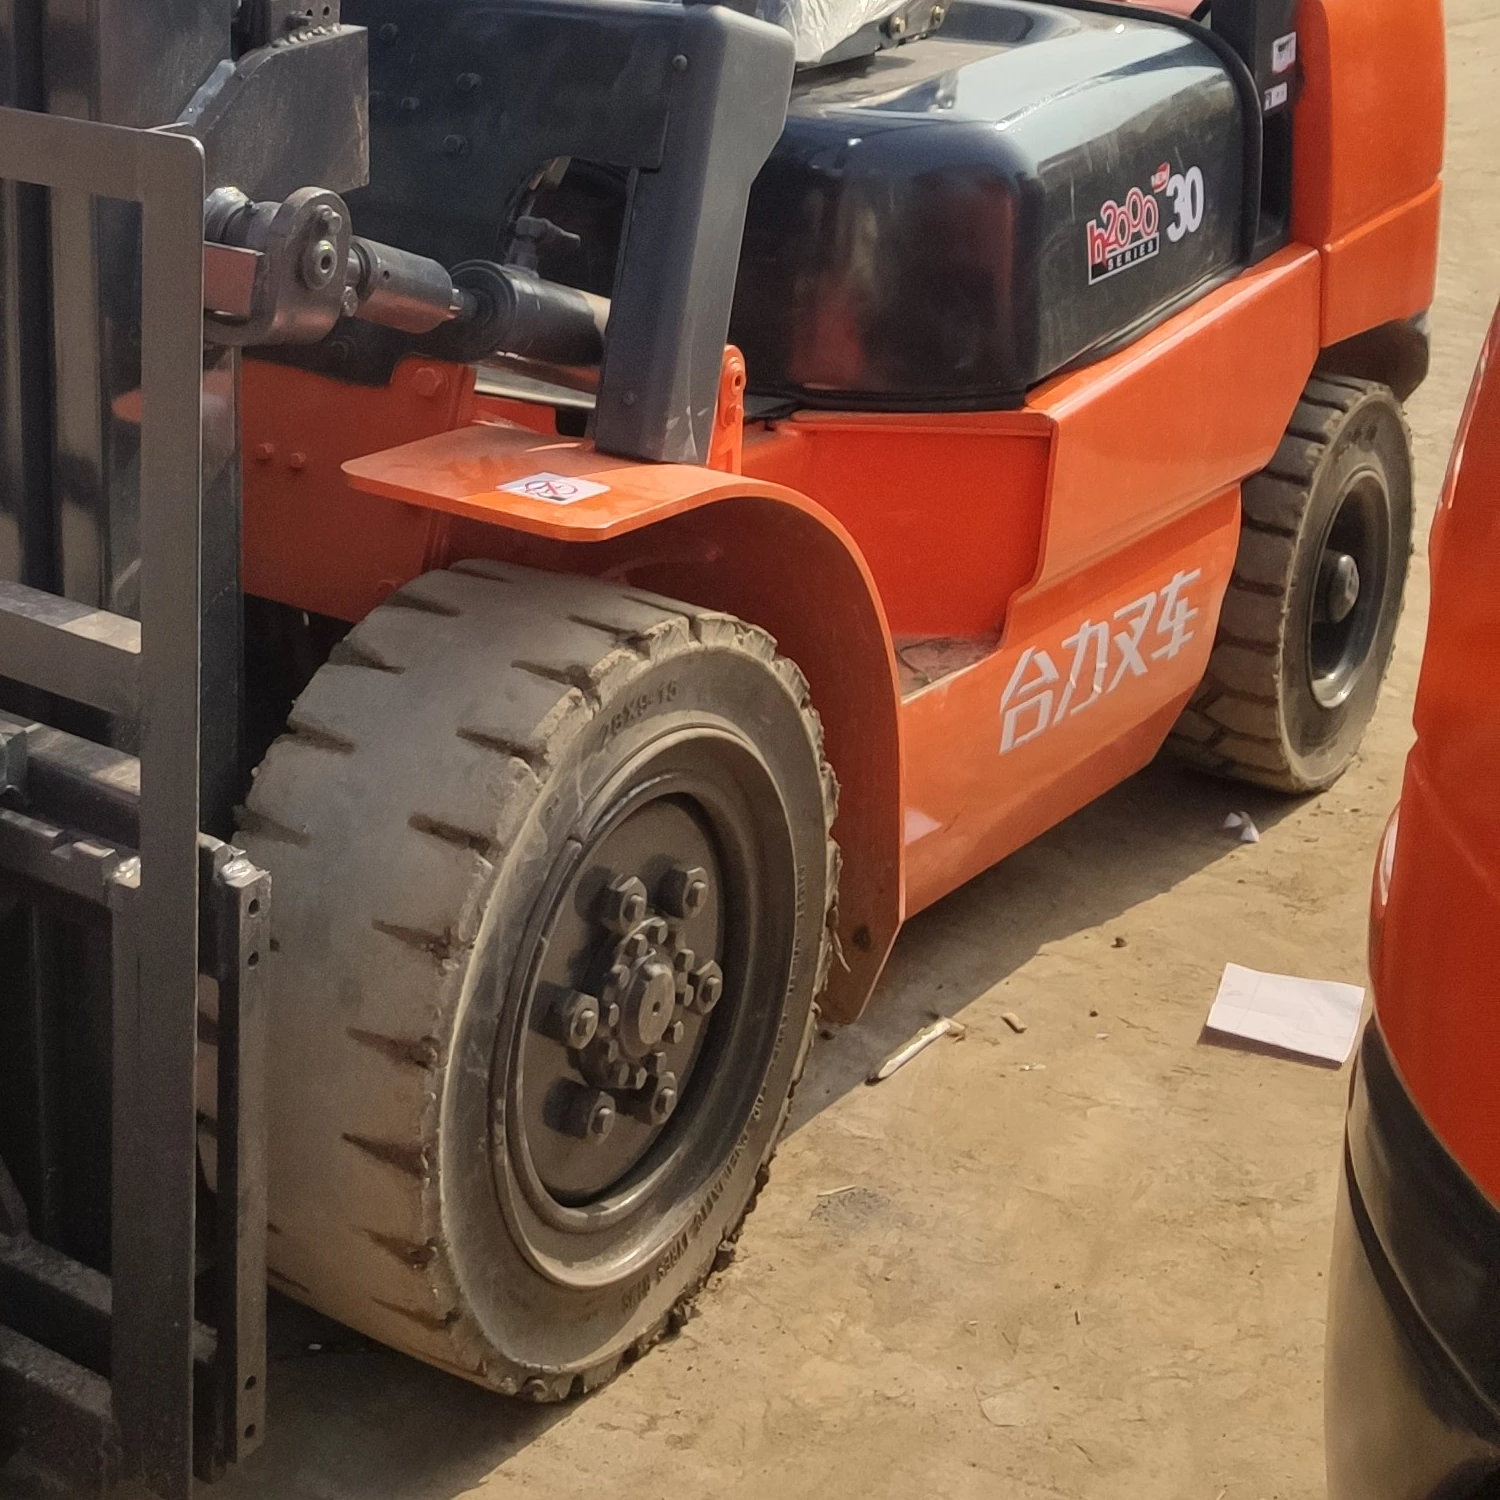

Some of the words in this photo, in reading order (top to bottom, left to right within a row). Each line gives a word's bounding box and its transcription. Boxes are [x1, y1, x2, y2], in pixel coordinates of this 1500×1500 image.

[1166, 165, 1205, 243] 30
[1107, 240, 1154, 272] SERIES
[998, 567, 1202, 756] 合力叉车
